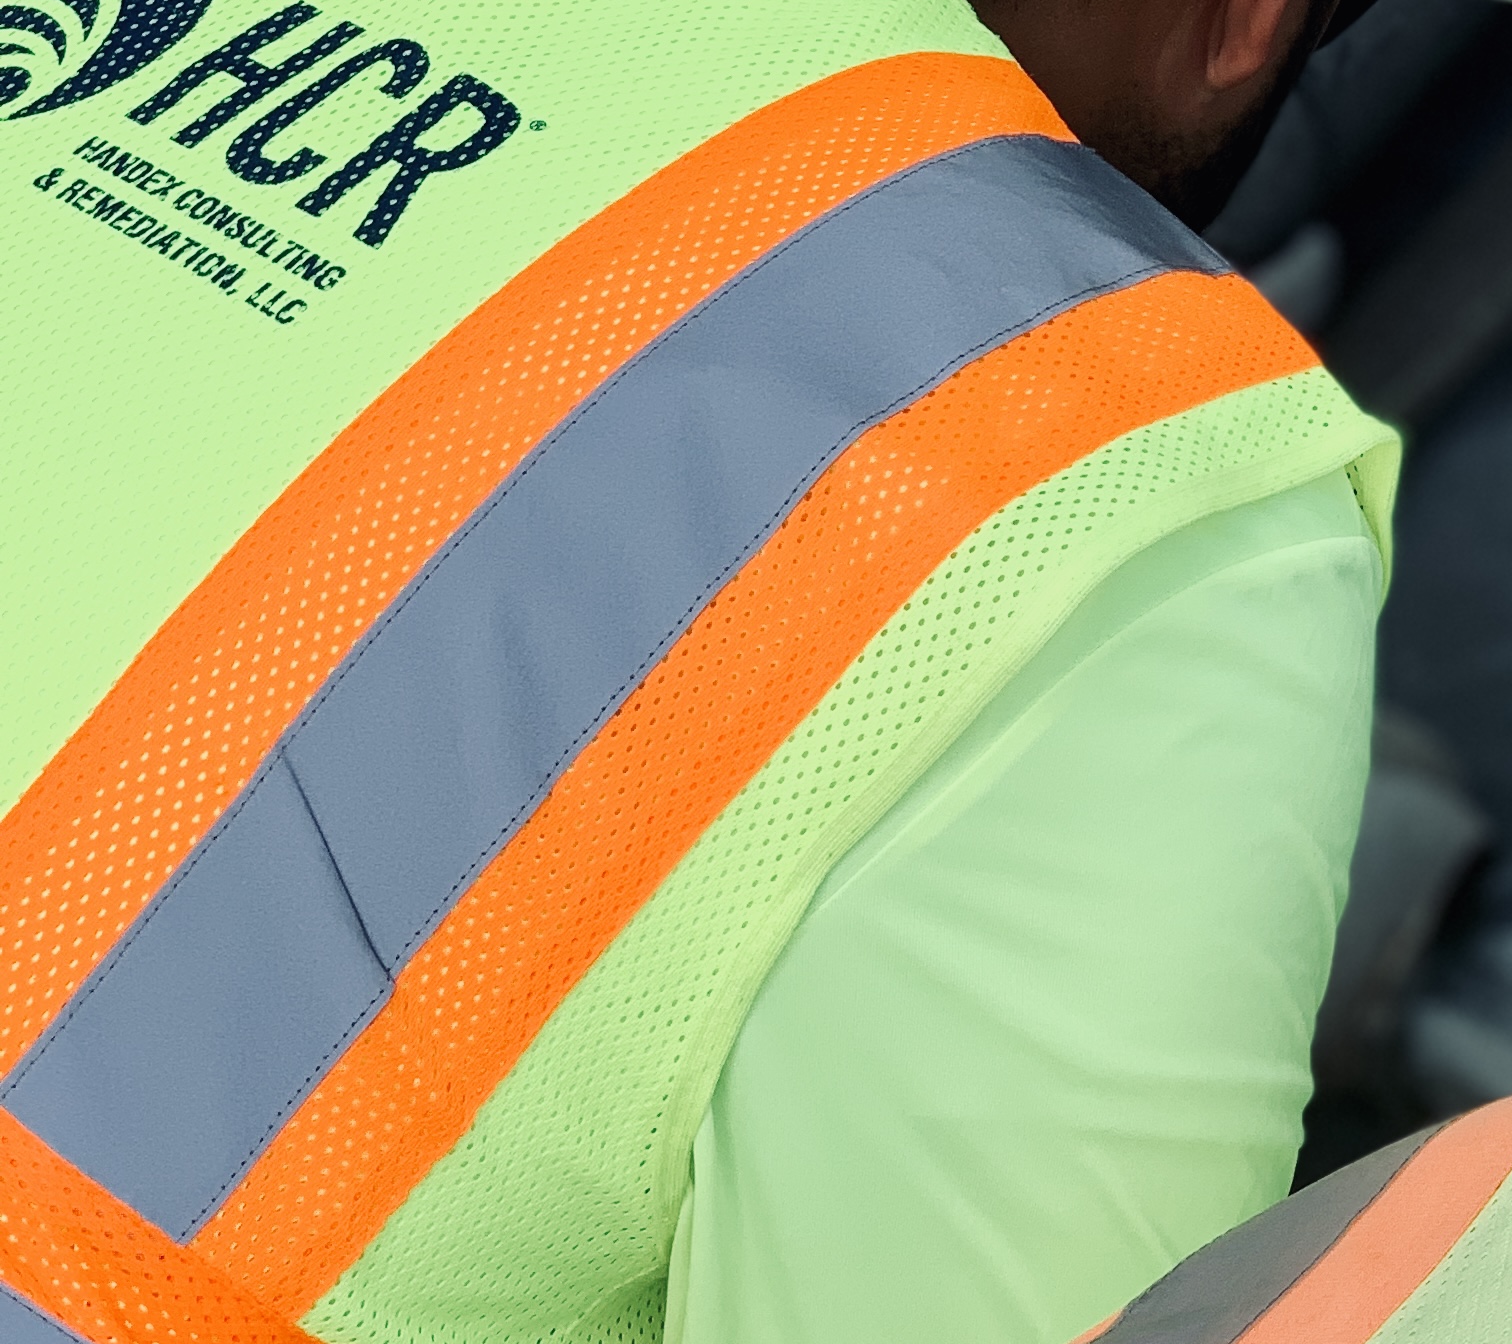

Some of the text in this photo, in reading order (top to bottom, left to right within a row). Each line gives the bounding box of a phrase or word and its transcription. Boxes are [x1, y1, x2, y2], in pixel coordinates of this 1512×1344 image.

[33, 167, 307, 324] & REMEDIATION, LLC
[73, 136, 346, 290] HANDEX CONSULTING
